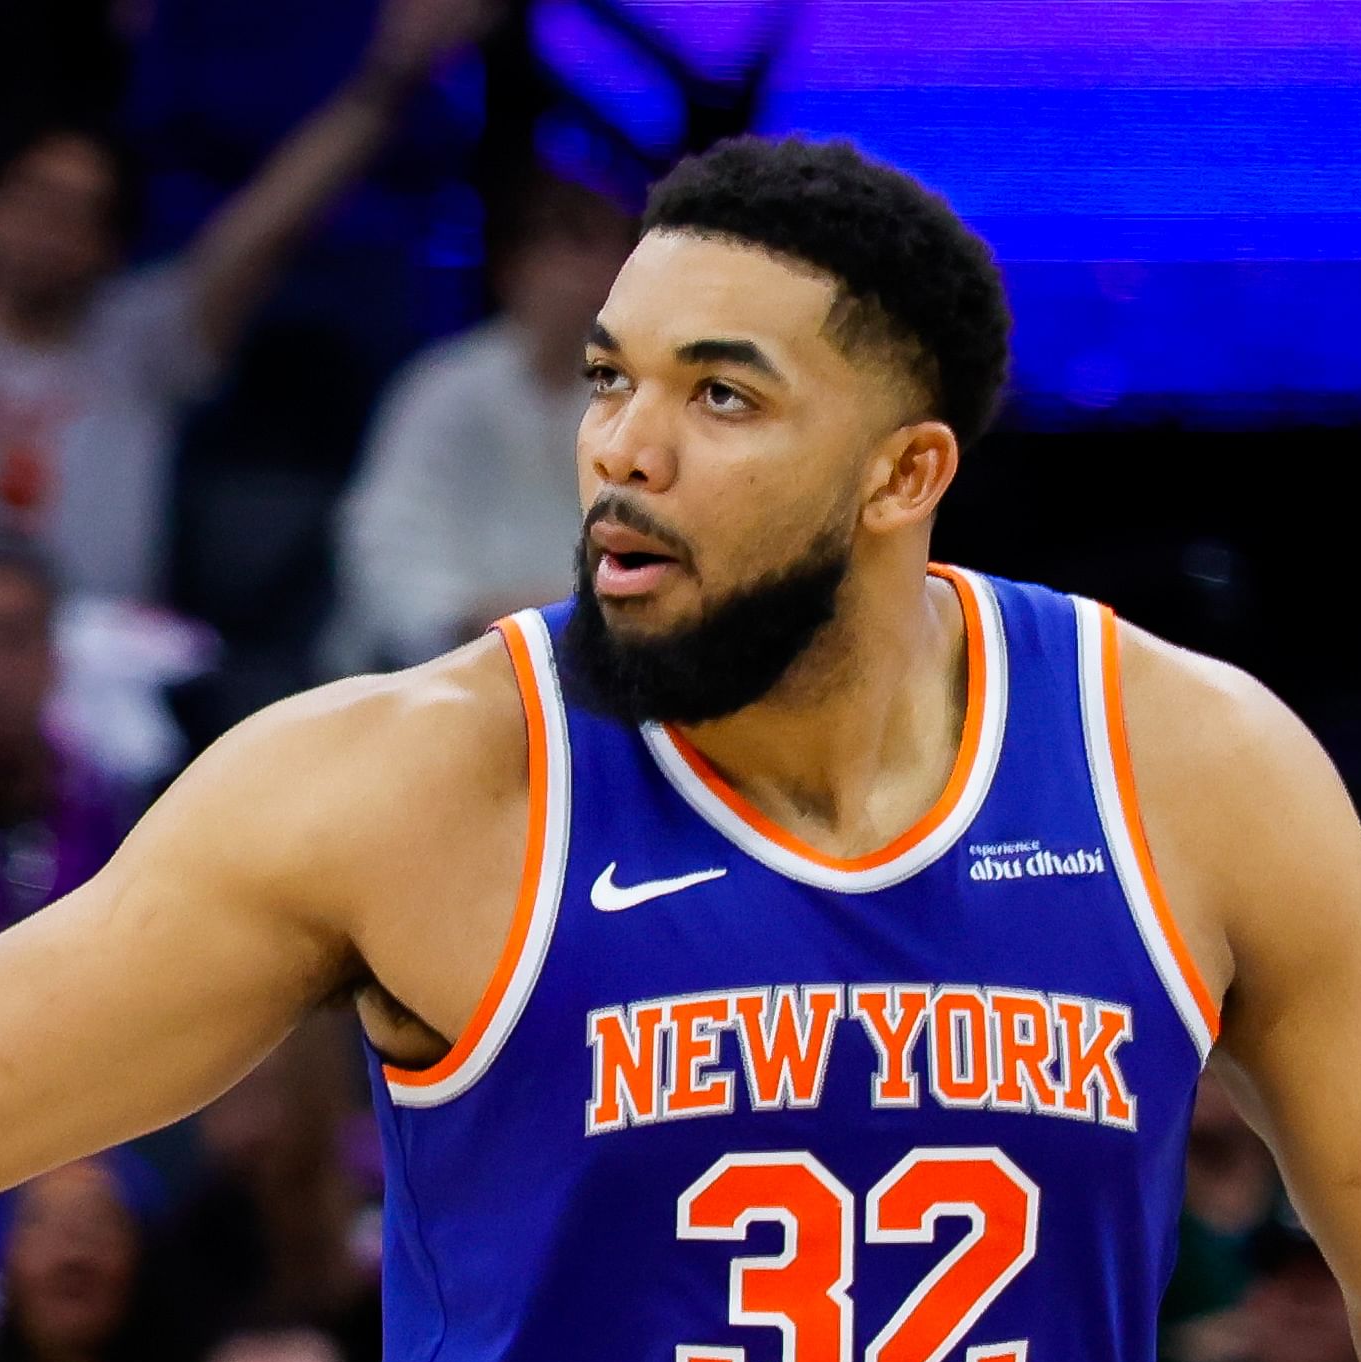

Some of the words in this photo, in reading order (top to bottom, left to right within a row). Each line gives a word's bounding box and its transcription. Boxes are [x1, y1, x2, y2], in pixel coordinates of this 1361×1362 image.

[970, 855, 1023, 881] abu
[1025, 847, 1105, 877] dhabi
[585, 983, 845, 1137] NEW
[846, 982, 1137, 1132] YORK
